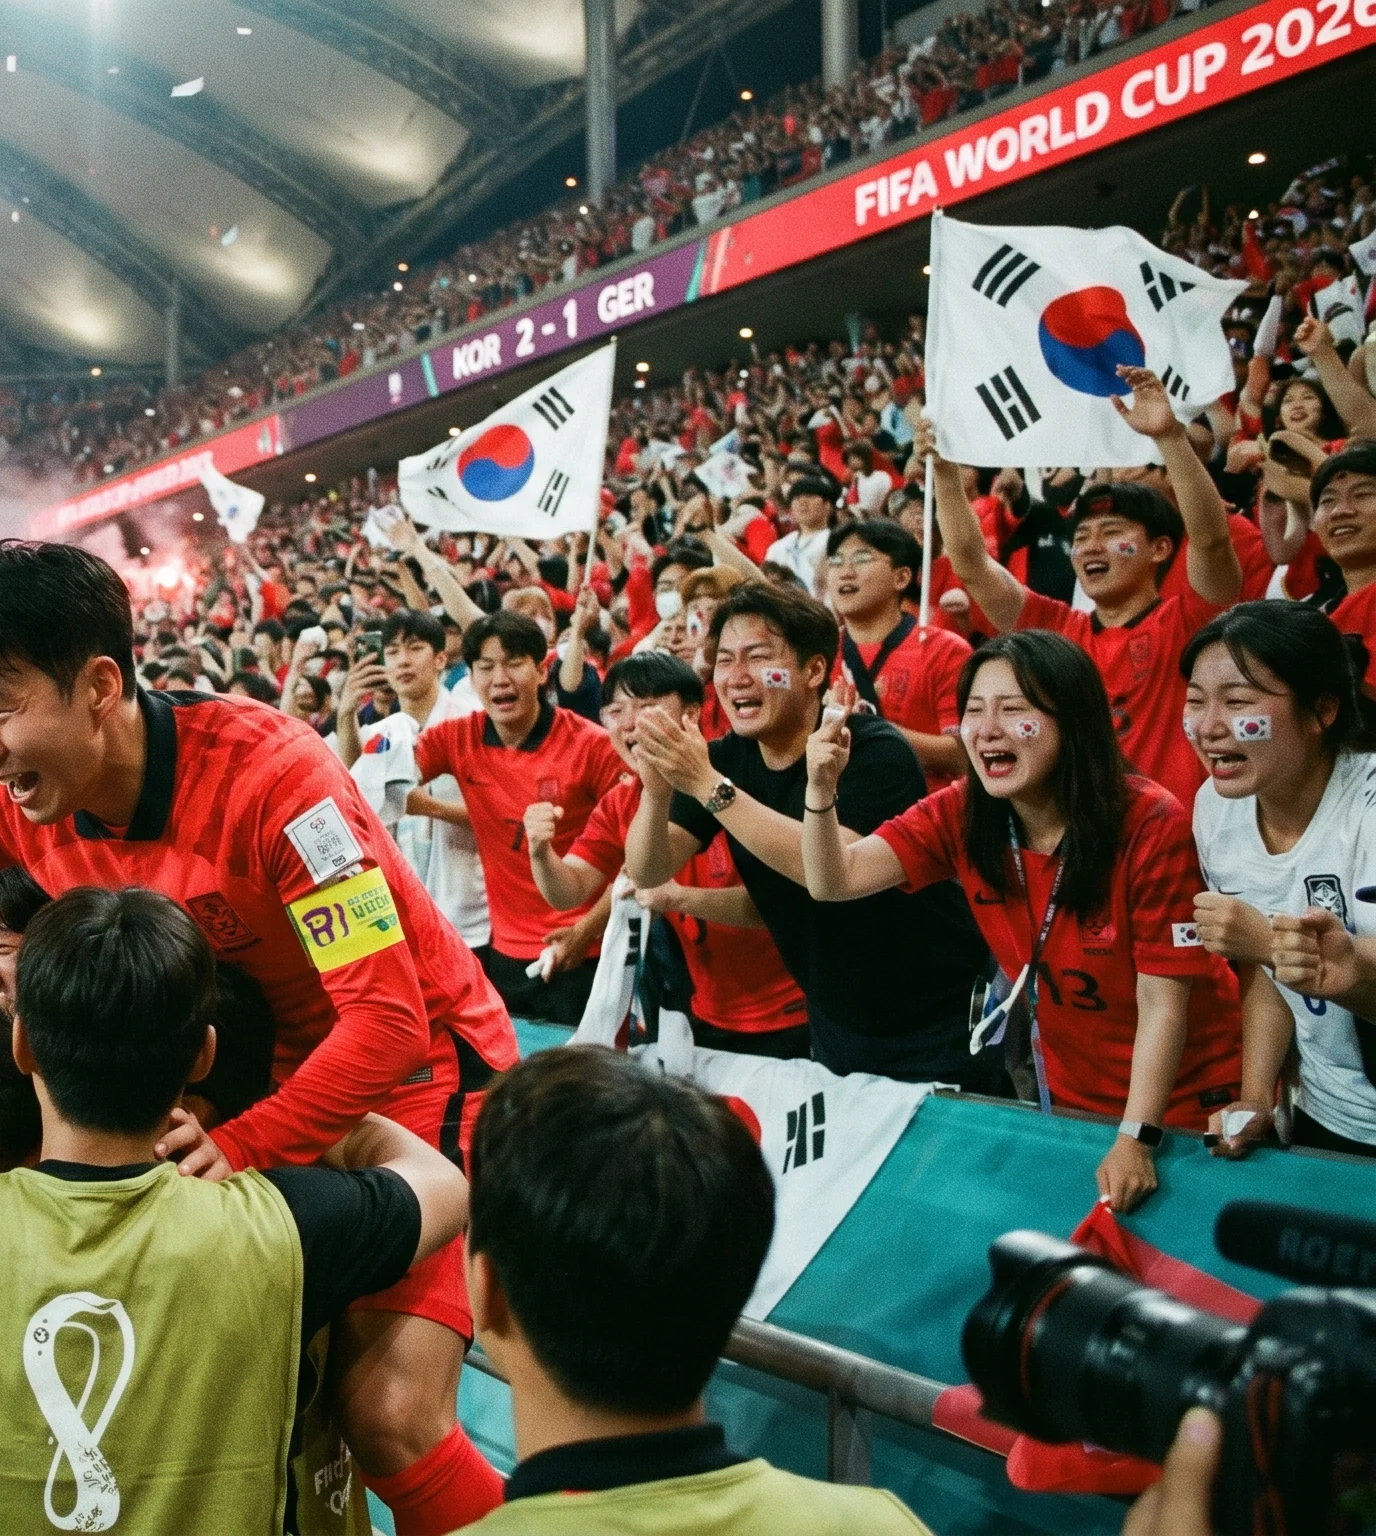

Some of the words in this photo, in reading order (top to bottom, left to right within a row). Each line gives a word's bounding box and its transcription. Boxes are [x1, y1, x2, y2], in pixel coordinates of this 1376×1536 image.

[855, 160, 938, 227] FIFA
[943, 91, 1110, 189] WORLD
[1121, 42, 1228, 119] CUP
[452, 332, 502, 380] KOR
[515, 318, 535, 358] 2
[562, 298, 578, 339] 1
[597, 271, 655, 324] GER
[1038, 960, 1108, 1013] 13
